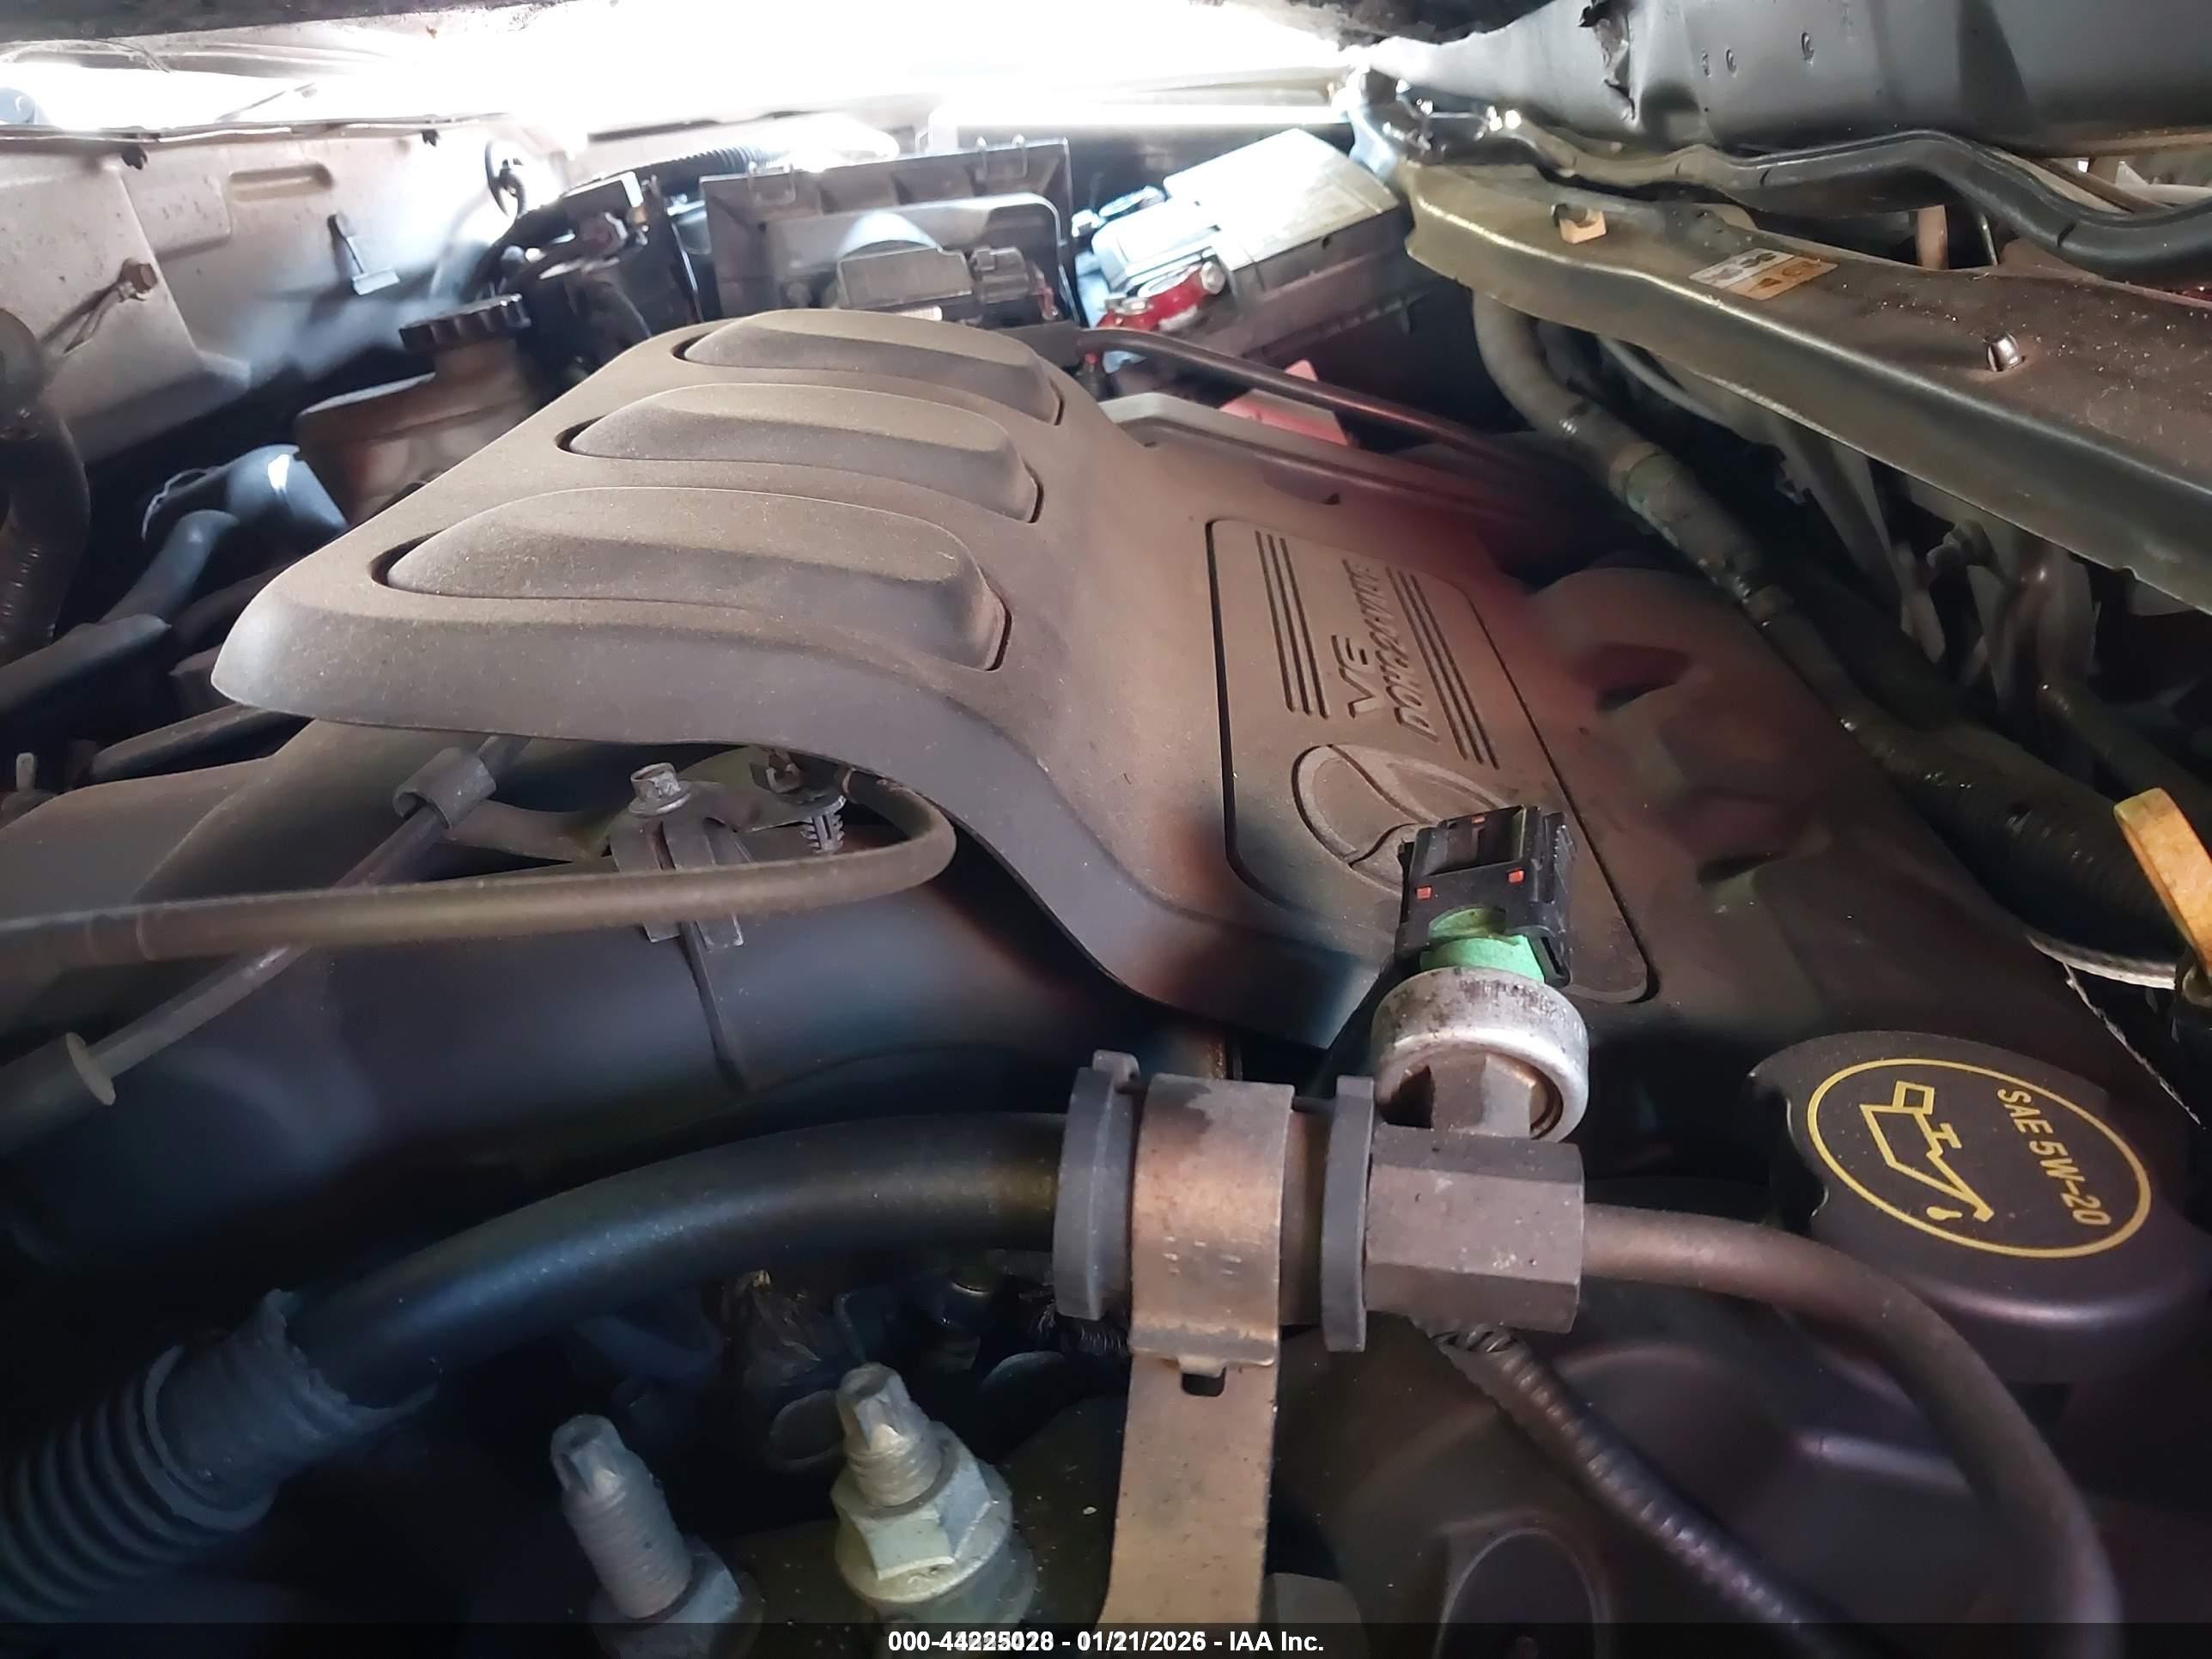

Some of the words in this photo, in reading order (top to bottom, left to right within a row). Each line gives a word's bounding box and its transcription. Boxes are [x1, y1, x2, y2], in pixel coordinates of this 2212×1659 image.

[1331, 634, 1379, 720] V6
[1996, 1087, 2054, 1134] SAE
[2028, 1139, 2112, 1226] 5W-20
